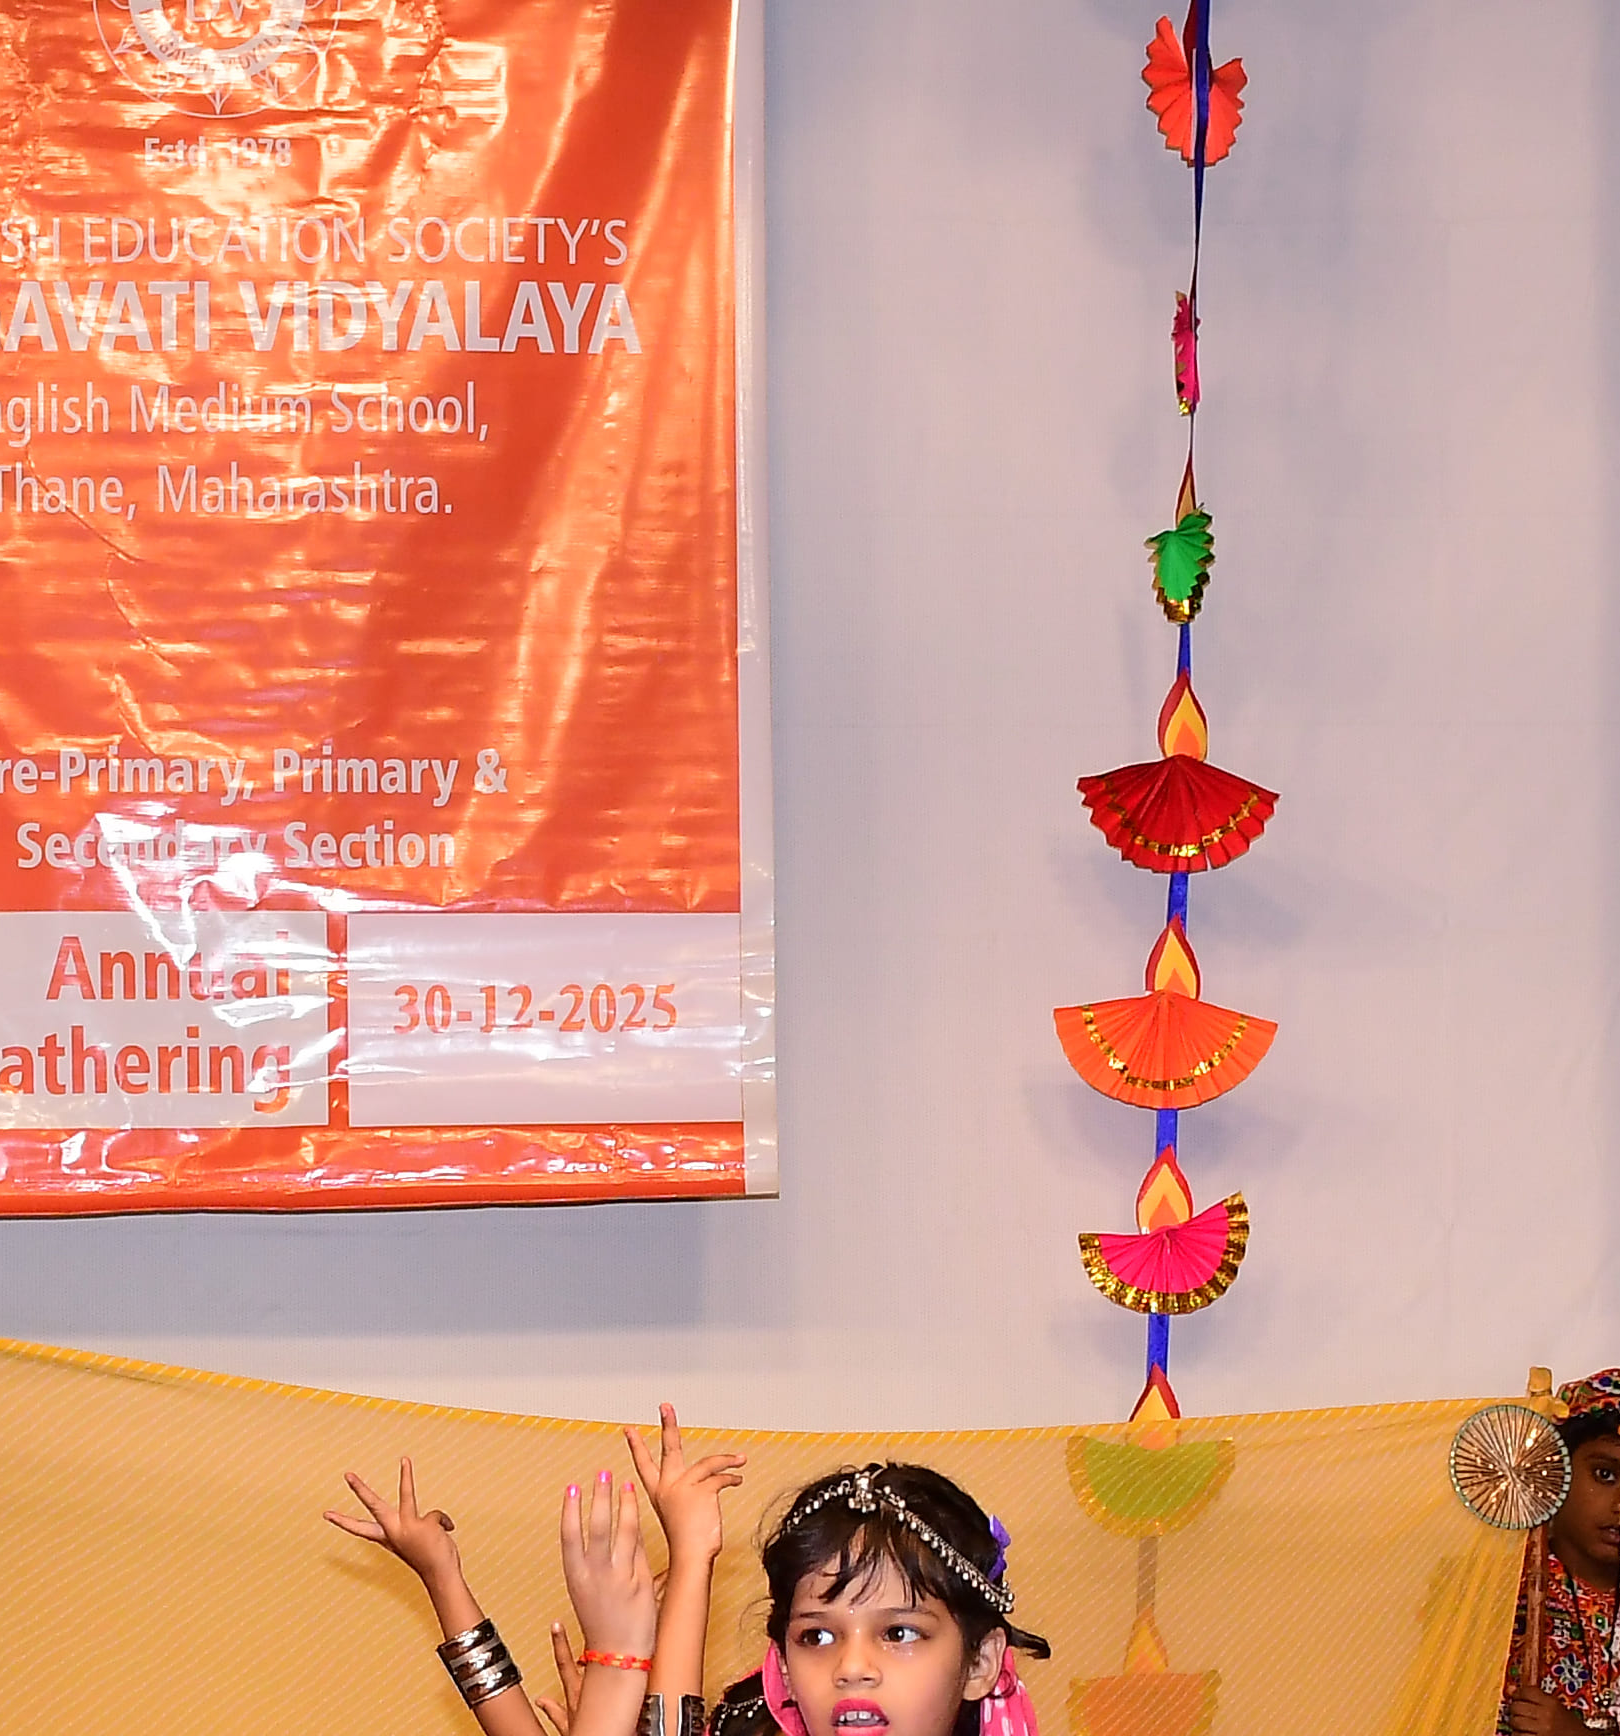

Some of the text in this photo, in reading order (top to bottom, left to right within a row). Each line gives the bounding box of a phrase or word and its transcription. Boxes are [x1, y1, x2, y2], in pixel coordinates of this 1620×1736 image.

[229, 136, 292, 168] 1978
[83, 216, 366, 264] EDUCATION
[387, 216, 629, 266] SOCIETY'S
[238, 280, 643, 354] VIDYALAYA
[129, 382, 313, 434] Medium
[330, 381, 489, 441] School,
[156, 461, 454, 514] Maharashtra.
[272, 745, 459, 807] Primary
[473, 747, 508, 794] &
[283, 819, 456, 868] Section
[46, 931, 291, 1001] Annual
[393, 983, 677, 1034] 30-12-2025
